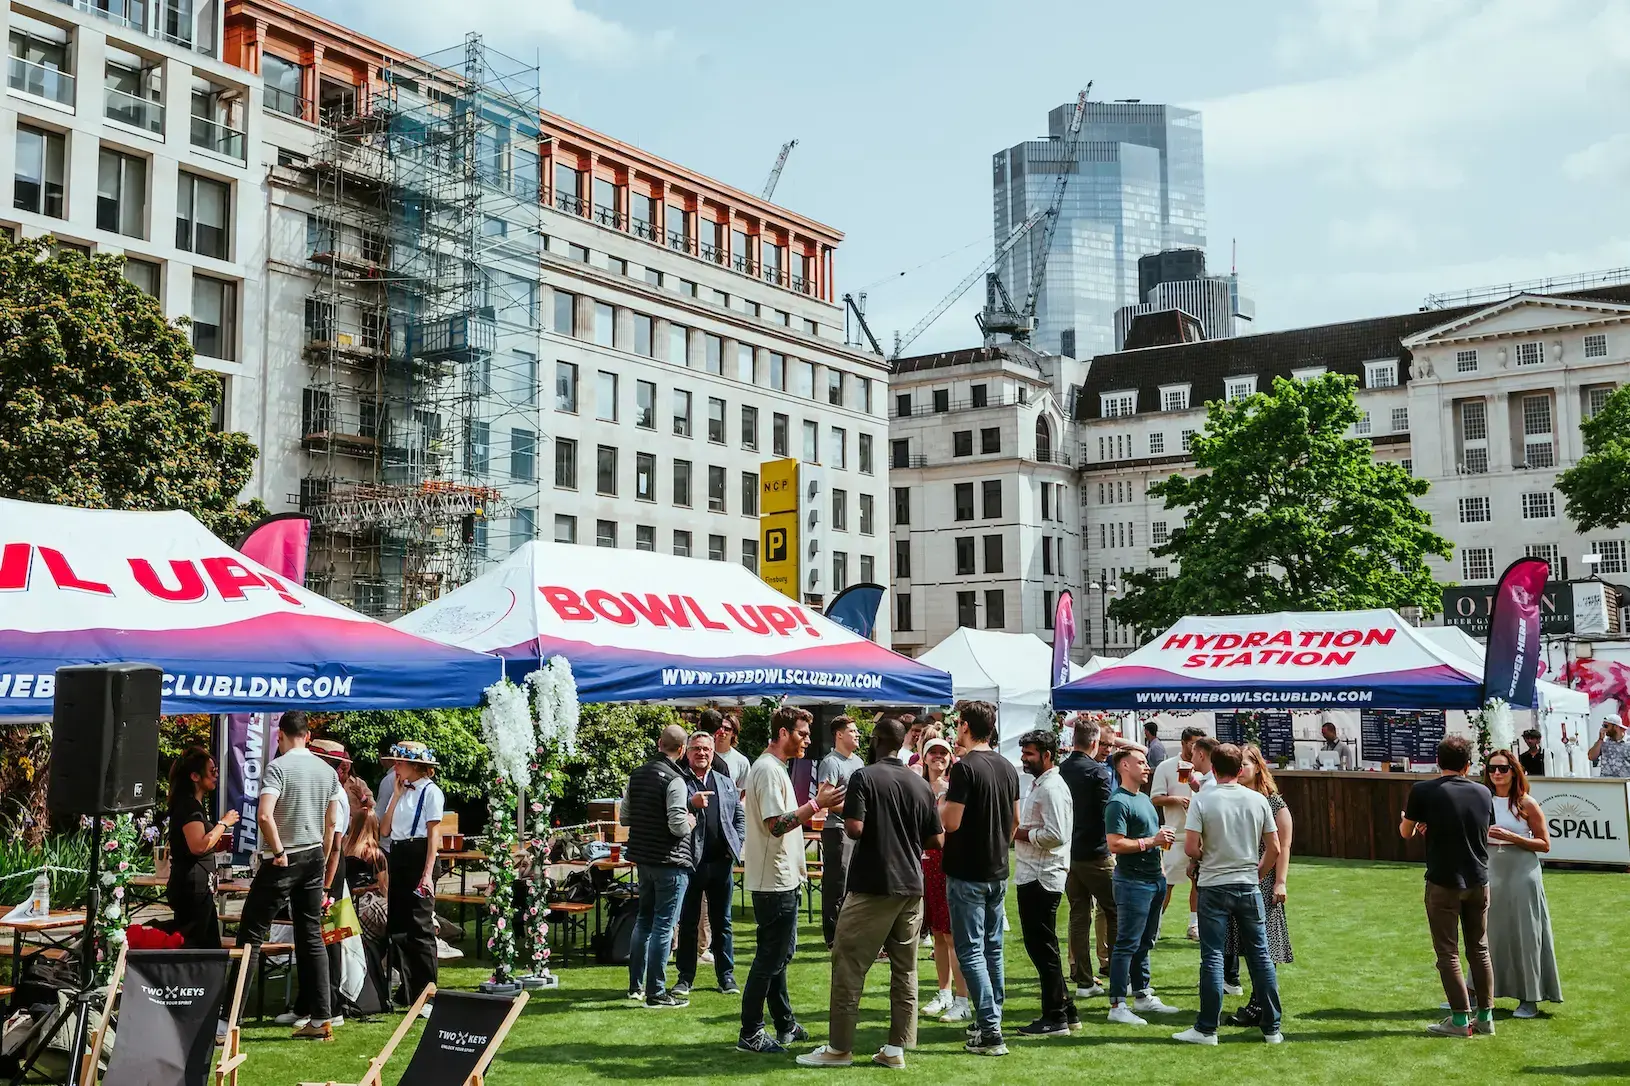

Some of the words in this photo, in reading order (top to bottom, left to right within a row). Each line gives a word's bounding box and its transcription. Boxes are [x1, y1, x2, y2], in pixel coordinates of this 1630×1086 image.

[764, 480, 788, 492] NCP
[127, 557, 305, 608] UP!
[538, 586, 733, 633] BOWL
[721, 603, 823, 640] UP!
[1160, 628, 1397, 651] HYDRATION
[1181, 650, 1356, 669] STATION
[1508, 653, 1524, 698] ORDER
[1516, 617, 1527, 653] HERE
[662, 669, 882, 688] WWW.THEBOWLSCLUBLDN.COM
[1136, 691, 1373, 704] WWW.THEBOWLSCLUBLDN.COM
[244, 713, 264, 799] BOWL
[238, 802, 258, 853] THE
[1548, 818, 1618, 840] SPALL
[141, 985, 164, 997] TWO
[180, 987, 205, 997] KEYS
[438, 1029, 457, 1041] TWO
[467, 1035, 488, 1045] KEYS
